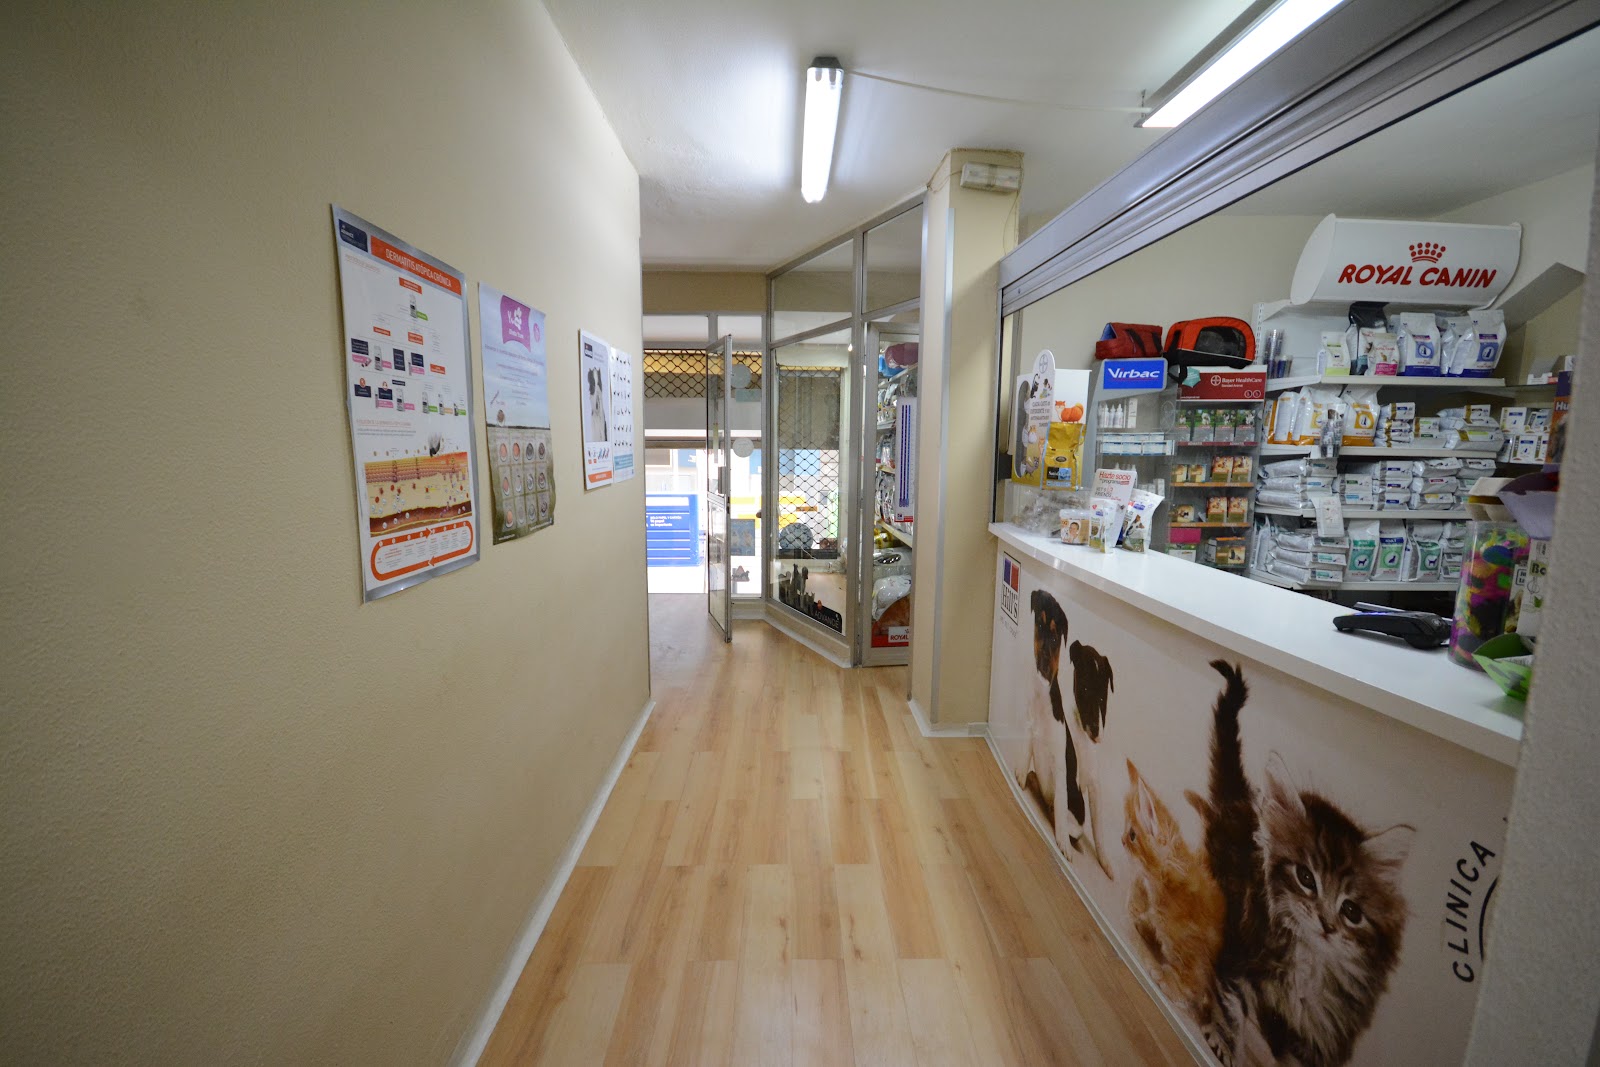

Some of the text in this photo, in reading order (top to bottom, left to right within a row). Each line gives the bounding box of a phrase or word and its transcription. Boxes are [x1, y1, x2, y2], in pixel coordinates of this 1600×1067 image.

[385, 248, 416, 270] DERMATITIS
[415, 263, 434, 280] ATÓPICA
[433, 272, 452, 287] CRÓNICA
[1338, 263, 1497, 288] ROYAL CANIN
[1107, 368, 1161, 379] Virbac
[1221, 377, 1235, 385] Bayer
[1099, 471, 1131, 481] Hazte socio
[1446, 840, 1496, 983] CLINICA
